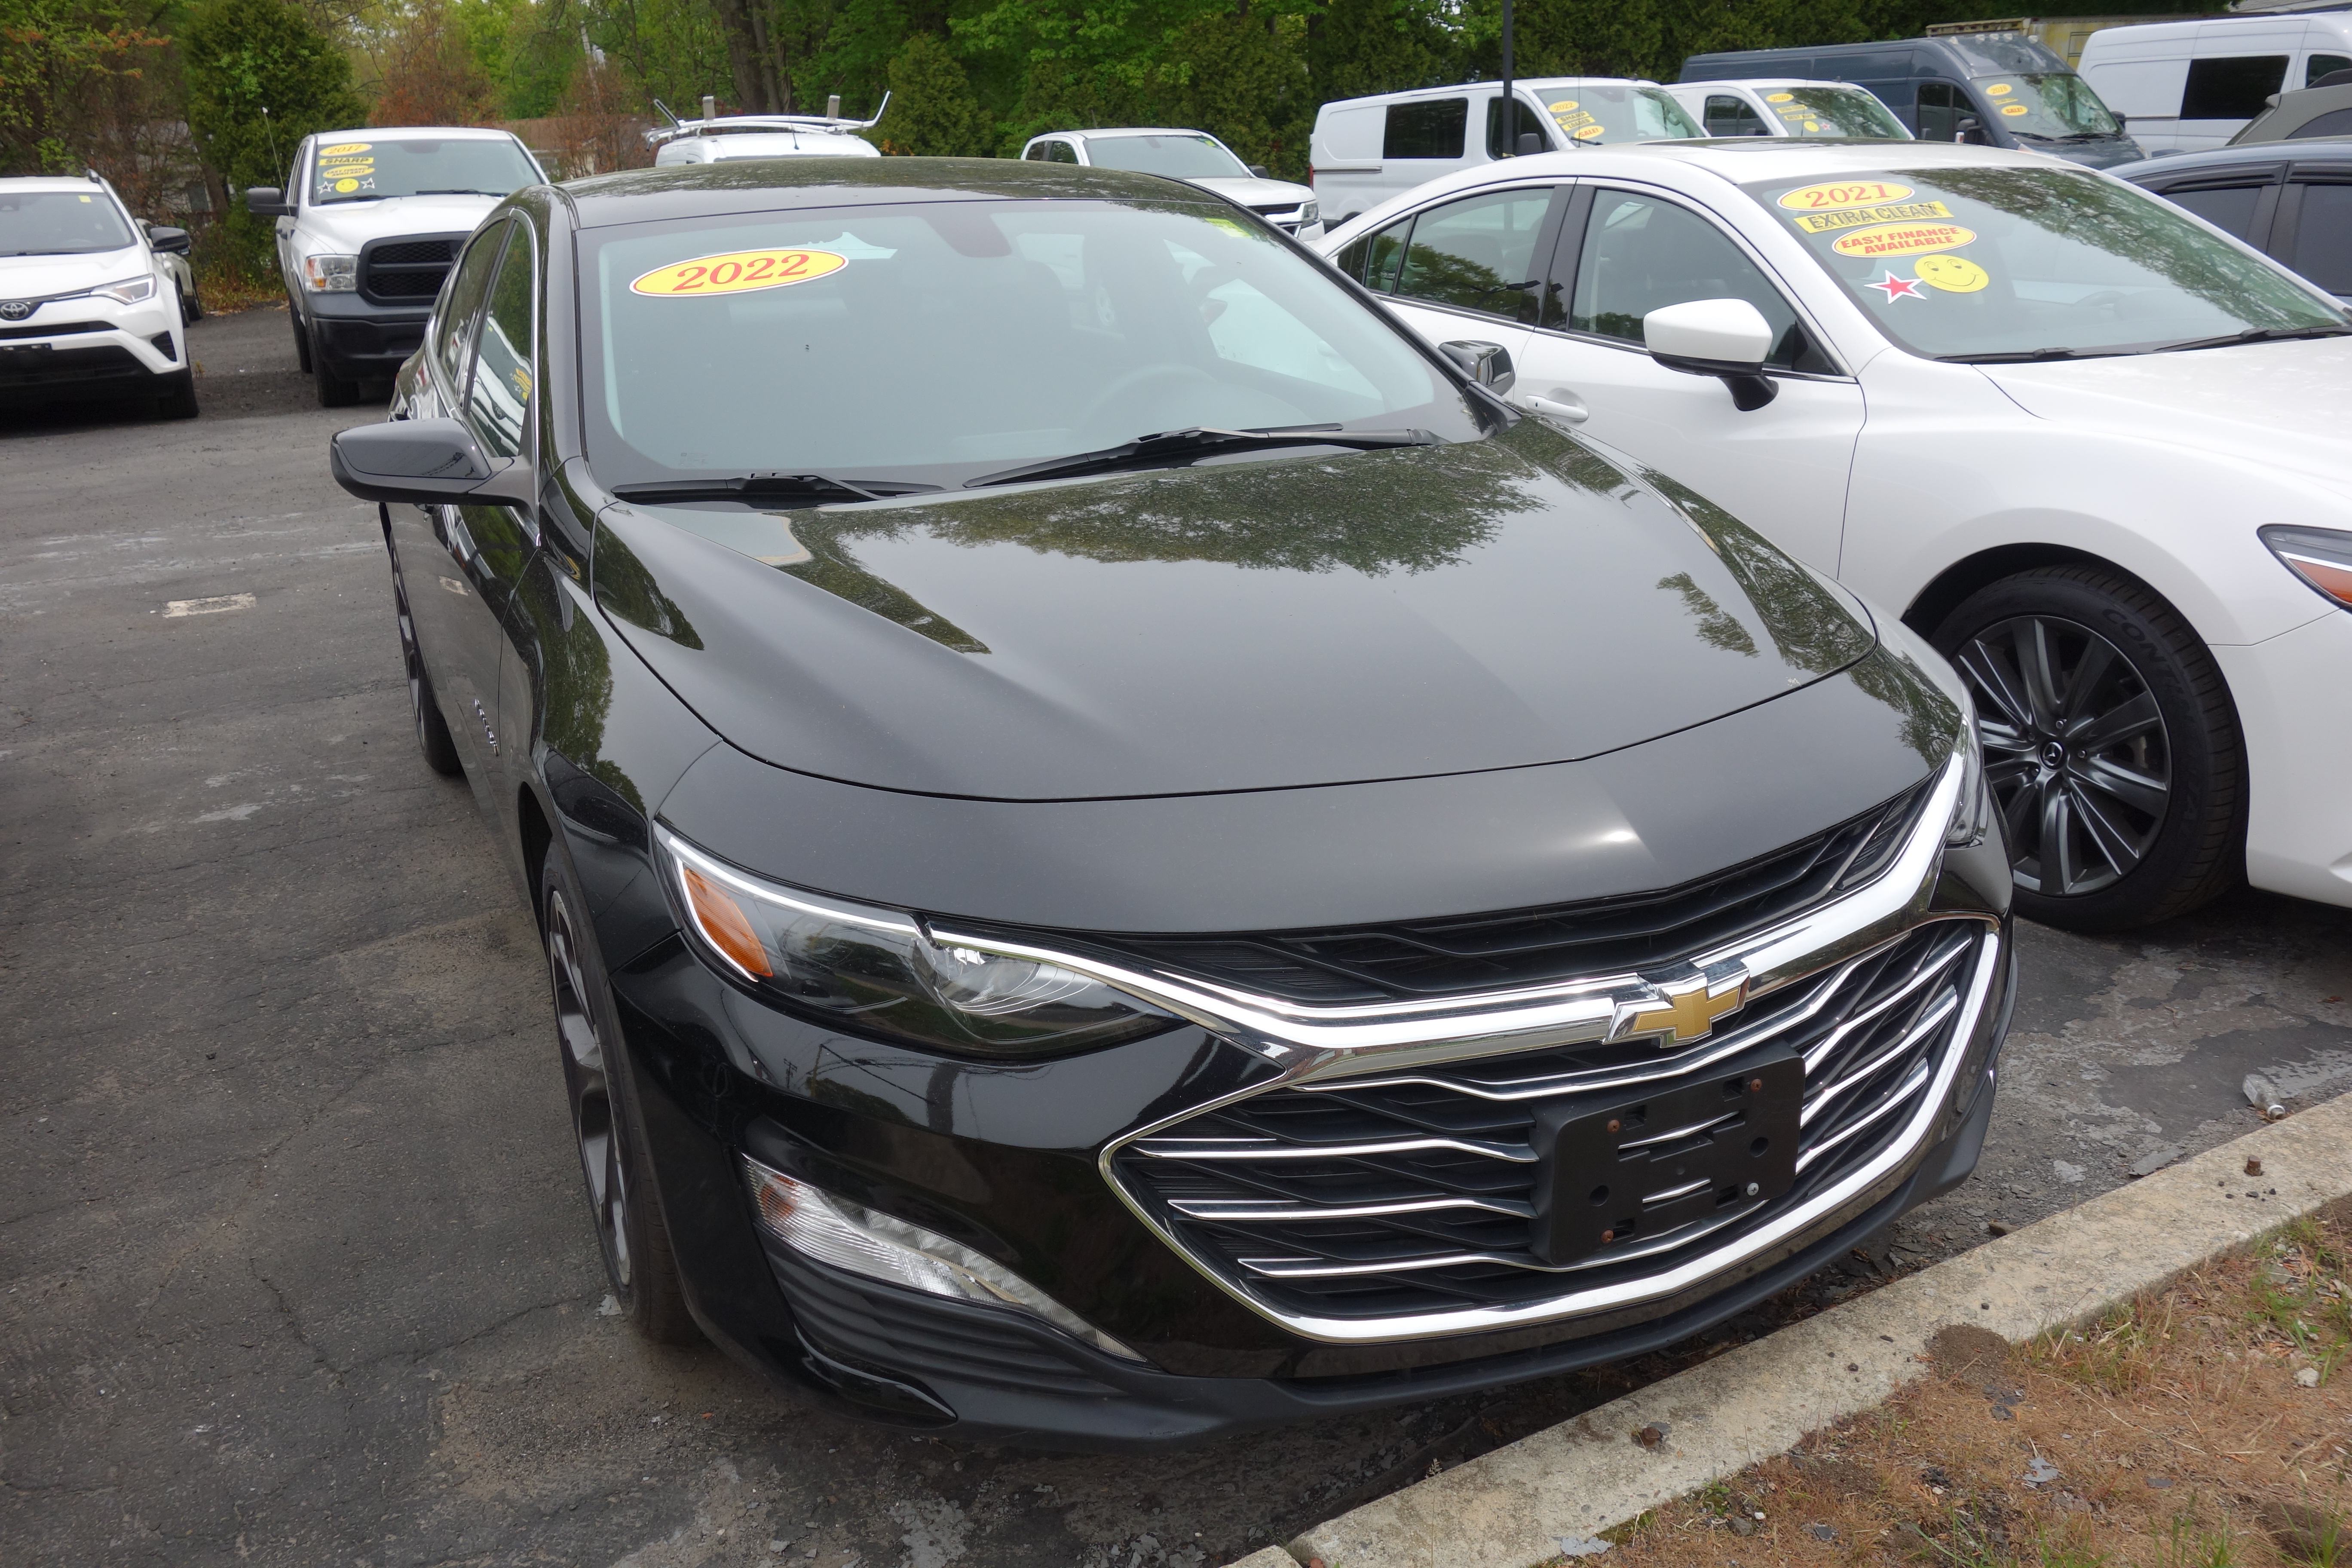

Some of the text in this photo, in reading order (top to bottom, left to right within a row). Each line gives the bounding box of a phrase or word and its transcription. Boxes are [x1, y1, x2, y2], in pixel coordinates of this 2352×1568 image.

[1554, 102, 1574, 111] 2022
[1560, 112, 1586, 122] SHARP
[1567, 118, 1590, 129] LOADED
[1579, 127, 1599, 137] SALE!
[328, 144, 361, 155] 2017
[1805, 184, 1892, 208] 2021
[1807, 203, 1940, 230] EXTRA CLEAN
[1841, 226, 1960, 248] EASY FINANCE
[1865, 236, 1955, 254] AVAILABLE
[672, 254, 810, 291] 2022
